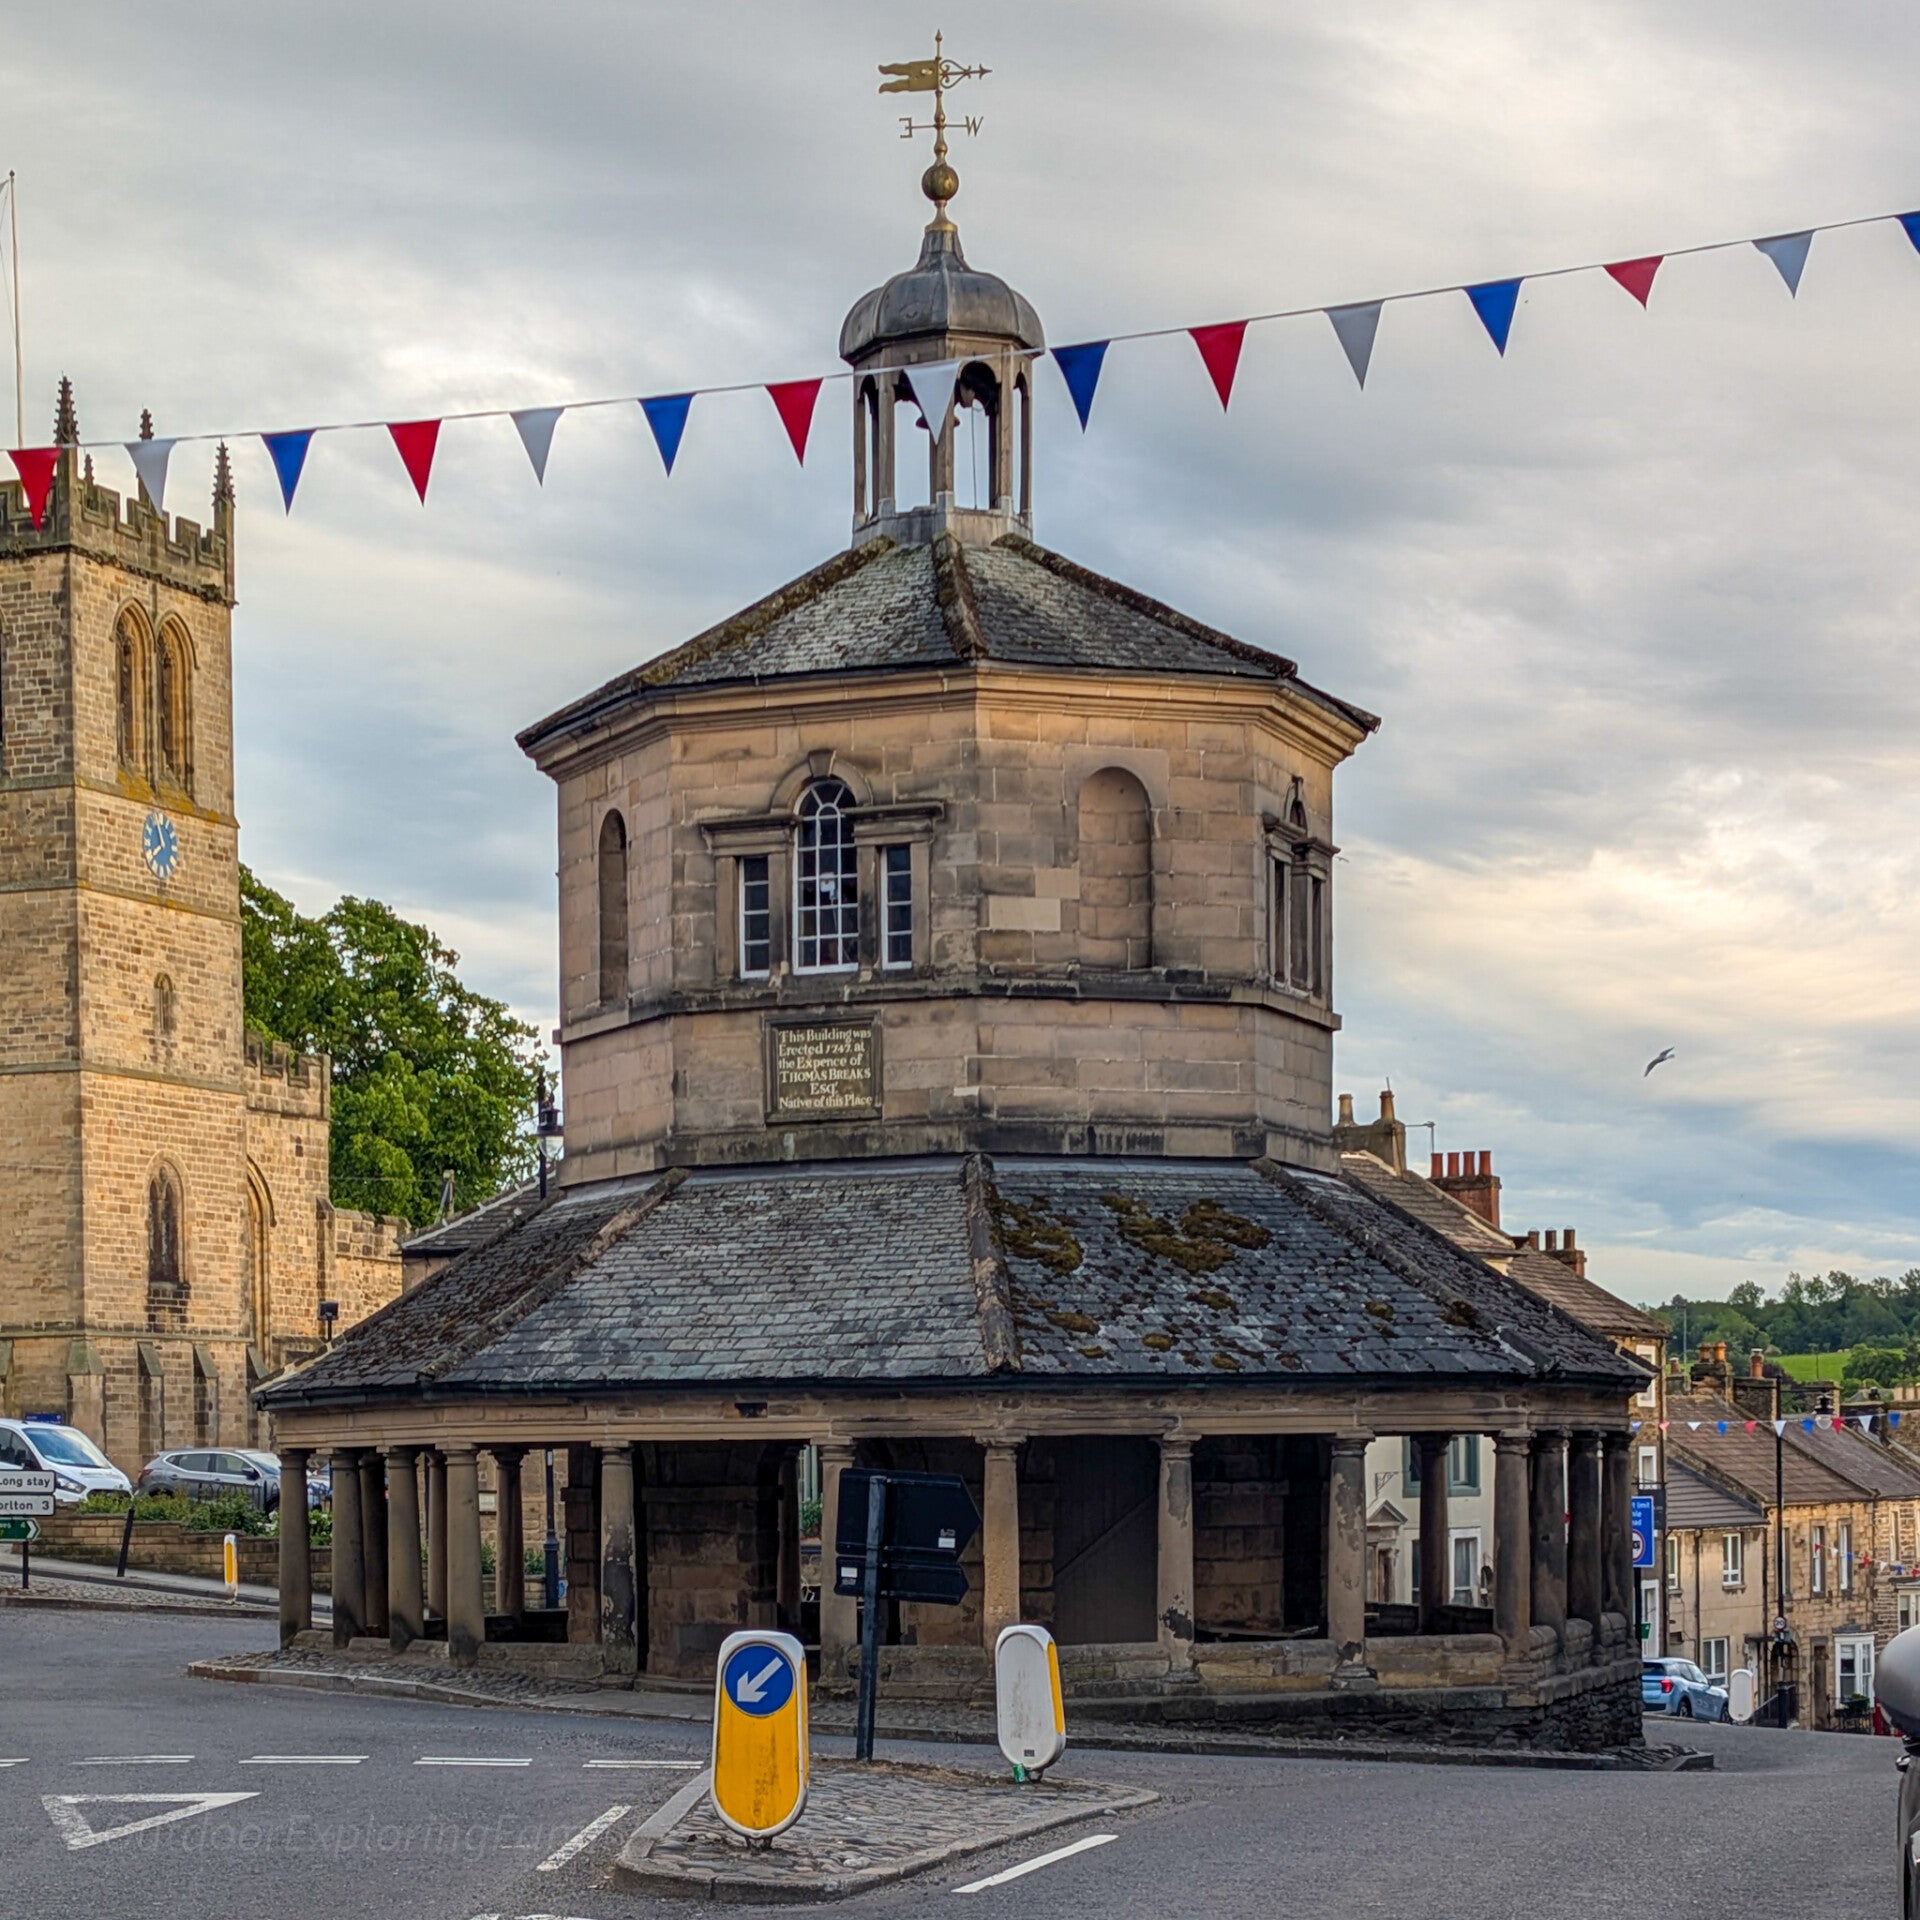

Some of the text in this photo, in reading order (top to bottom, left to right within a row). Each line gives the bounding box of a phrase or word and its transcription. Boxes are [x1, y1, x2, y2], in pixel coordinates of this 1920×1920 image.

[965, 115, 984, 137] W
[779, 1028, 872, 1043] This Building was
[779, 1042, 823, 1057] Erected
[854, 1042, 866, 1052] at
[778, 1053, 863, 1071] the Expence of
[779, 1070, 828, 1083] THOMAS
[779, 1094, 873, 1110] Native of this Place
[0, 1477, 50, 1488] ong stay
[42, 1501, 49, 1510] 3
